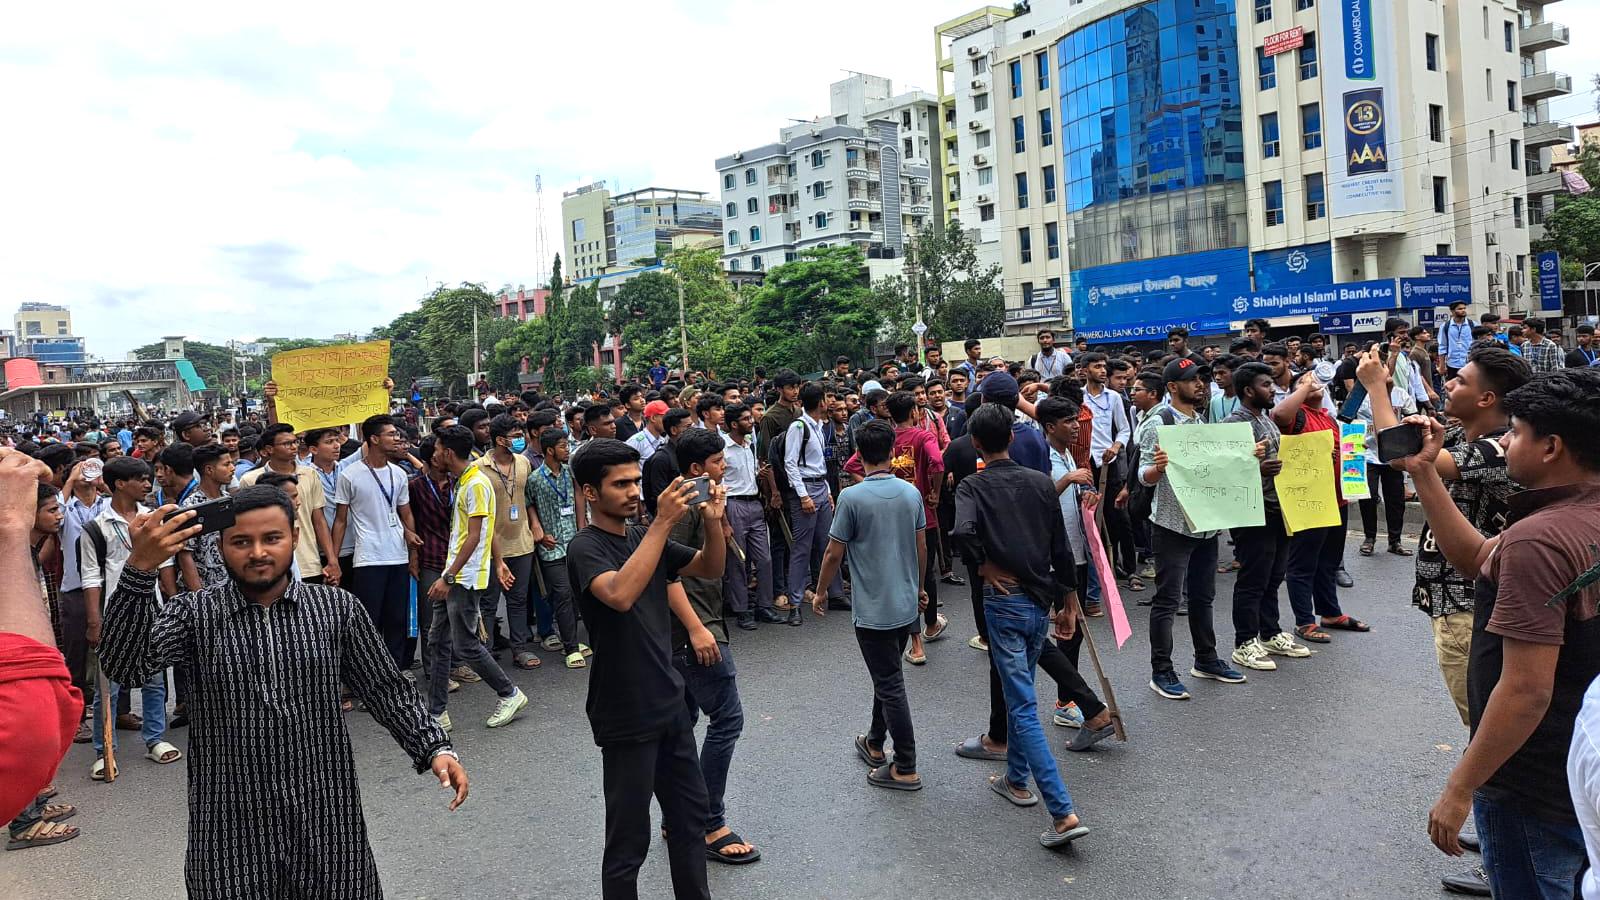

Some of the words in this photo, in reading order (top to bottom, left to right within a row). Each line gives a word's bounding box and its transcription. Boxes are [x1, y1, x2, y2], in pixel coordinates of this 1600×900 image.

[1352, 0, 1363, 56] COMMERCIAL
[1264, 34, 1280, 46] FLOOR
[1280, 31, 1289, 42] FOR
[1355, 105, 1374, 122] 13
[1350, 142, 1386, 166] AAA
[1144, 275, 1182, 293] ইসলামী
[1252, 293, 1301, 309] Shahjalal
[1304, 290, 1337, 303] Islami
[1340, 287, 1371, 299] Bank
[1289, 307, 1306, 315] Uttara
[1354, 317, 1374, 327] ATM
[1074, 329, 1112, 339] COMMERCIAL
[1112, 328, 1133, 337] BANK
[1133, 326, 1145, 335] OF
